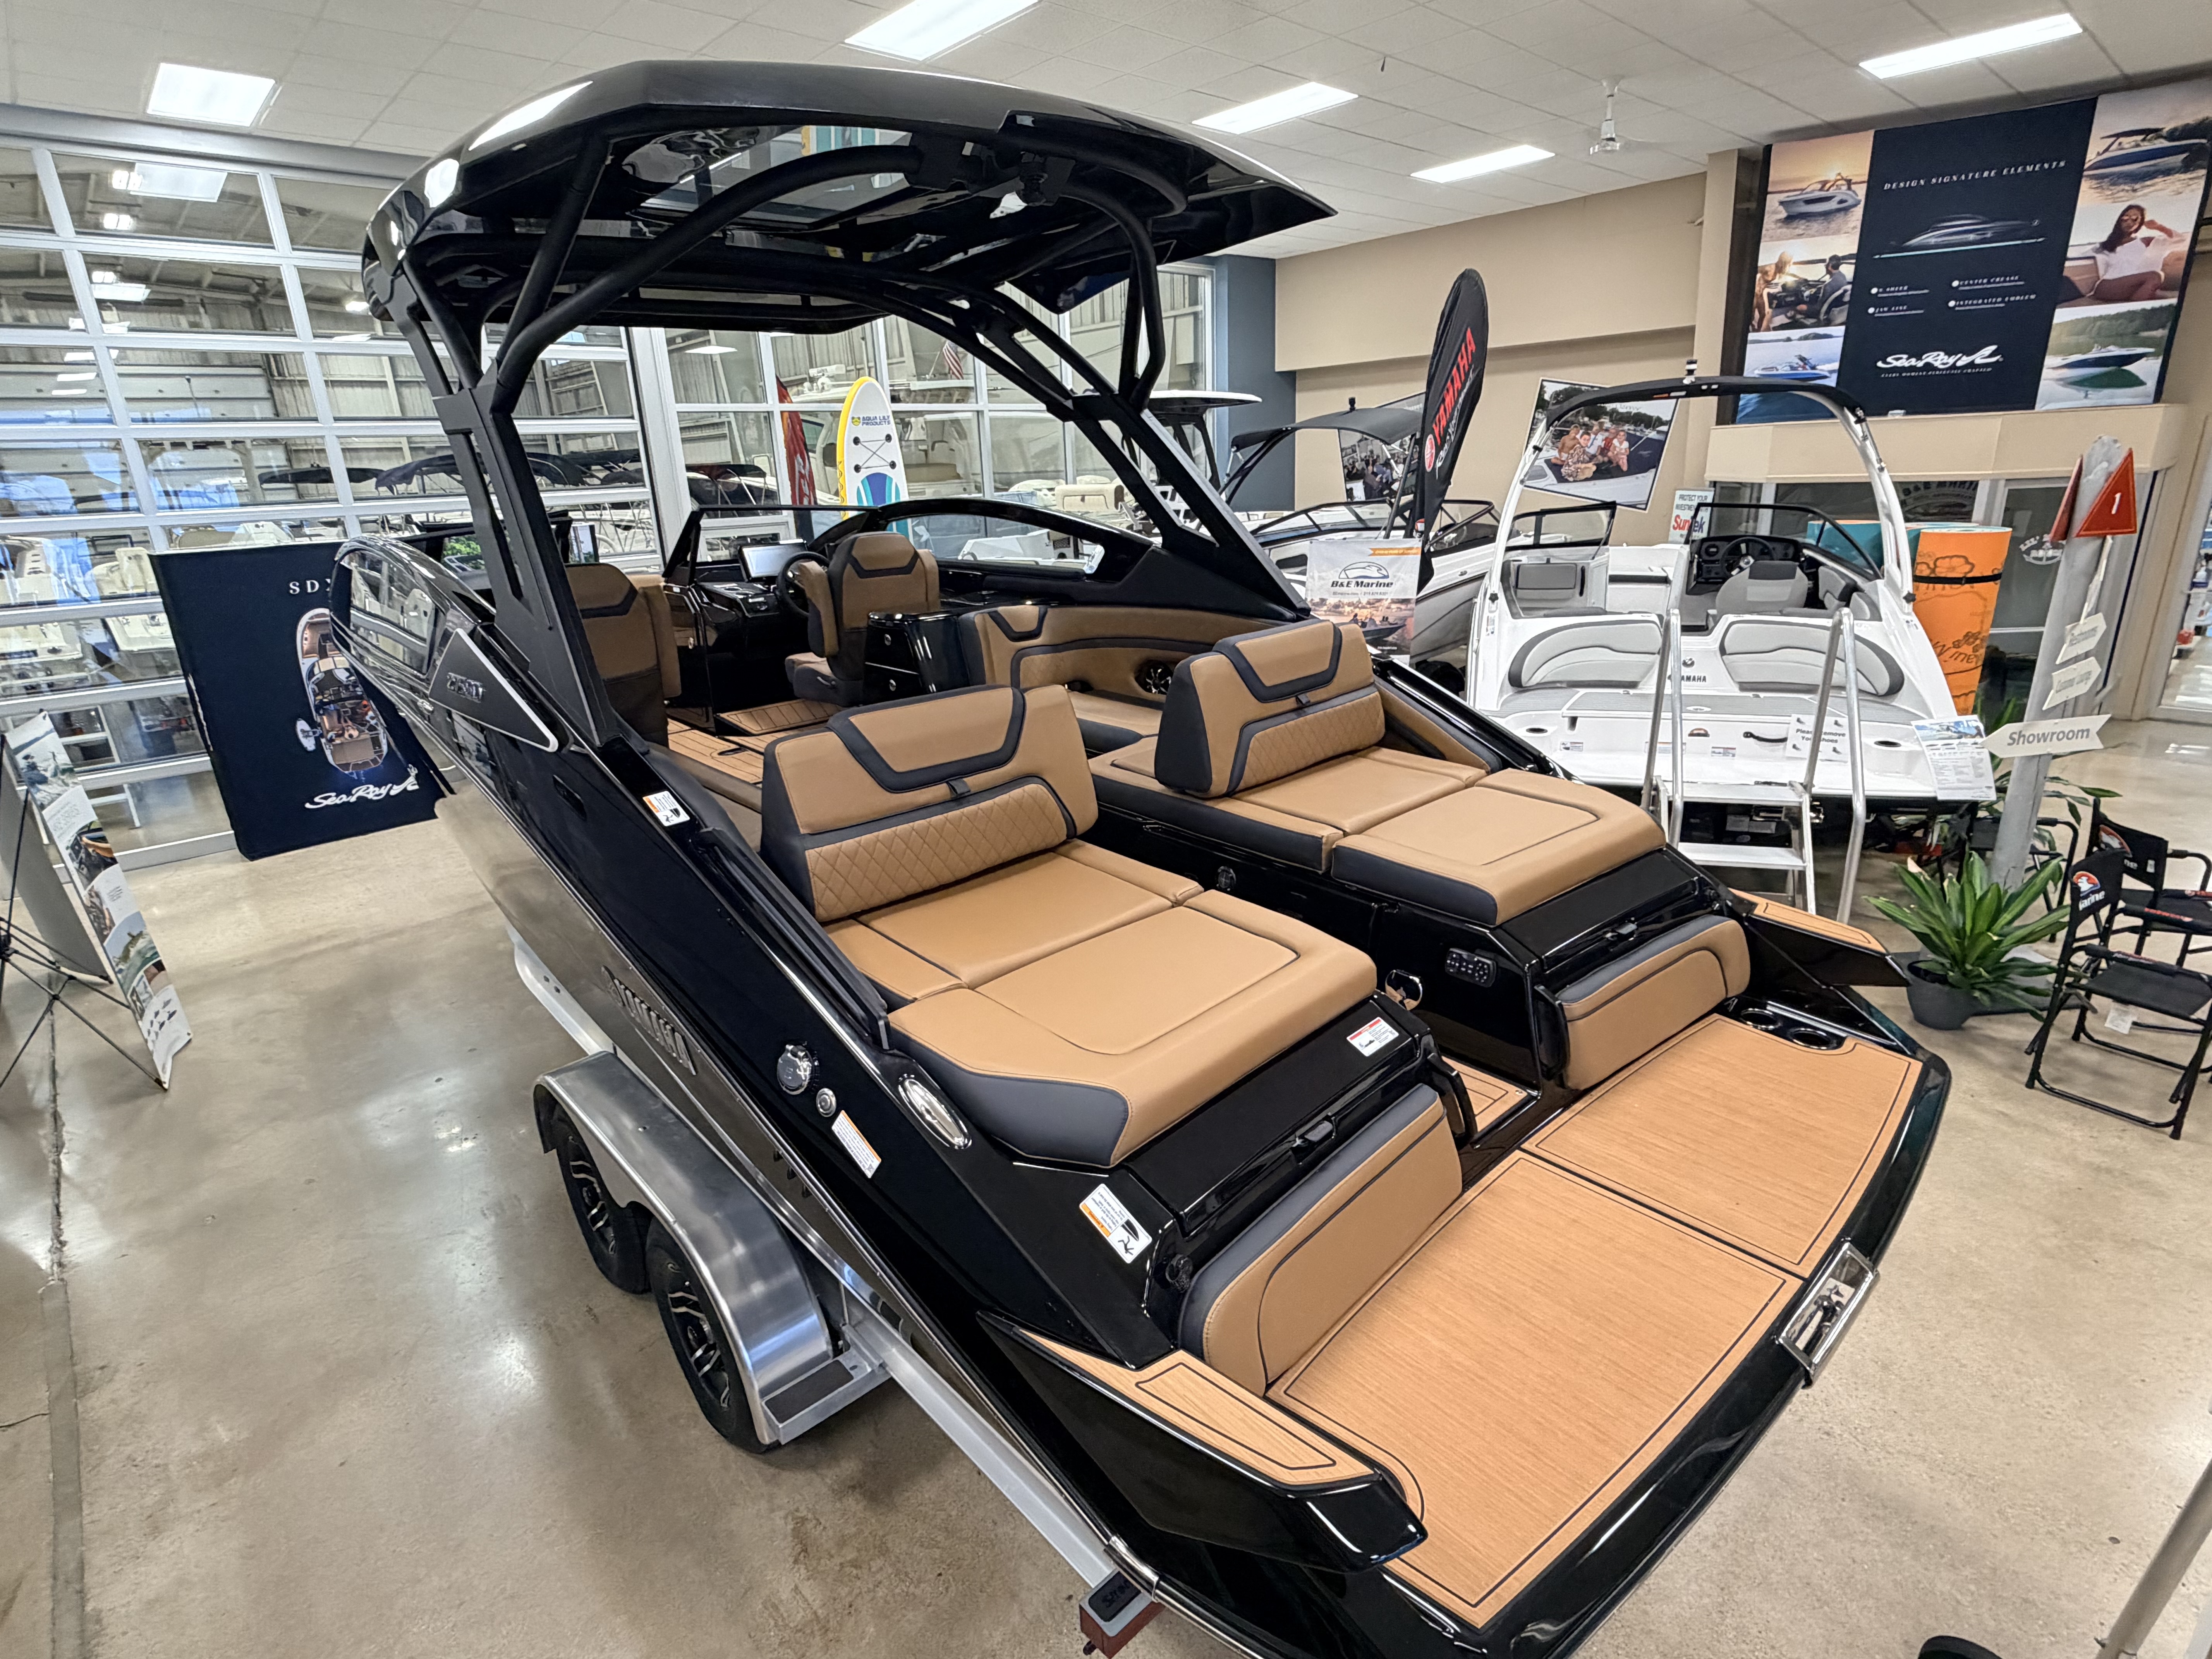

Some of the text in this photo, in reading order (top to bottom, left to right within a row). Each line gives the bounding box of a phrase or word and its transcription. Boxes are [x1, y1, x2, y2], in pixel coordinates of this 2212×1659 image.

[1884, 160, 2066, 190] DESIGN SIGNATURE ELEMENTS
[1433, 327, 1476, 446] YAMAHA
[2112, 492, 2121, 514] 1
[1673, 514, 1705, 534] Sunek
[2007, 728, 2090, 746] Showroom
